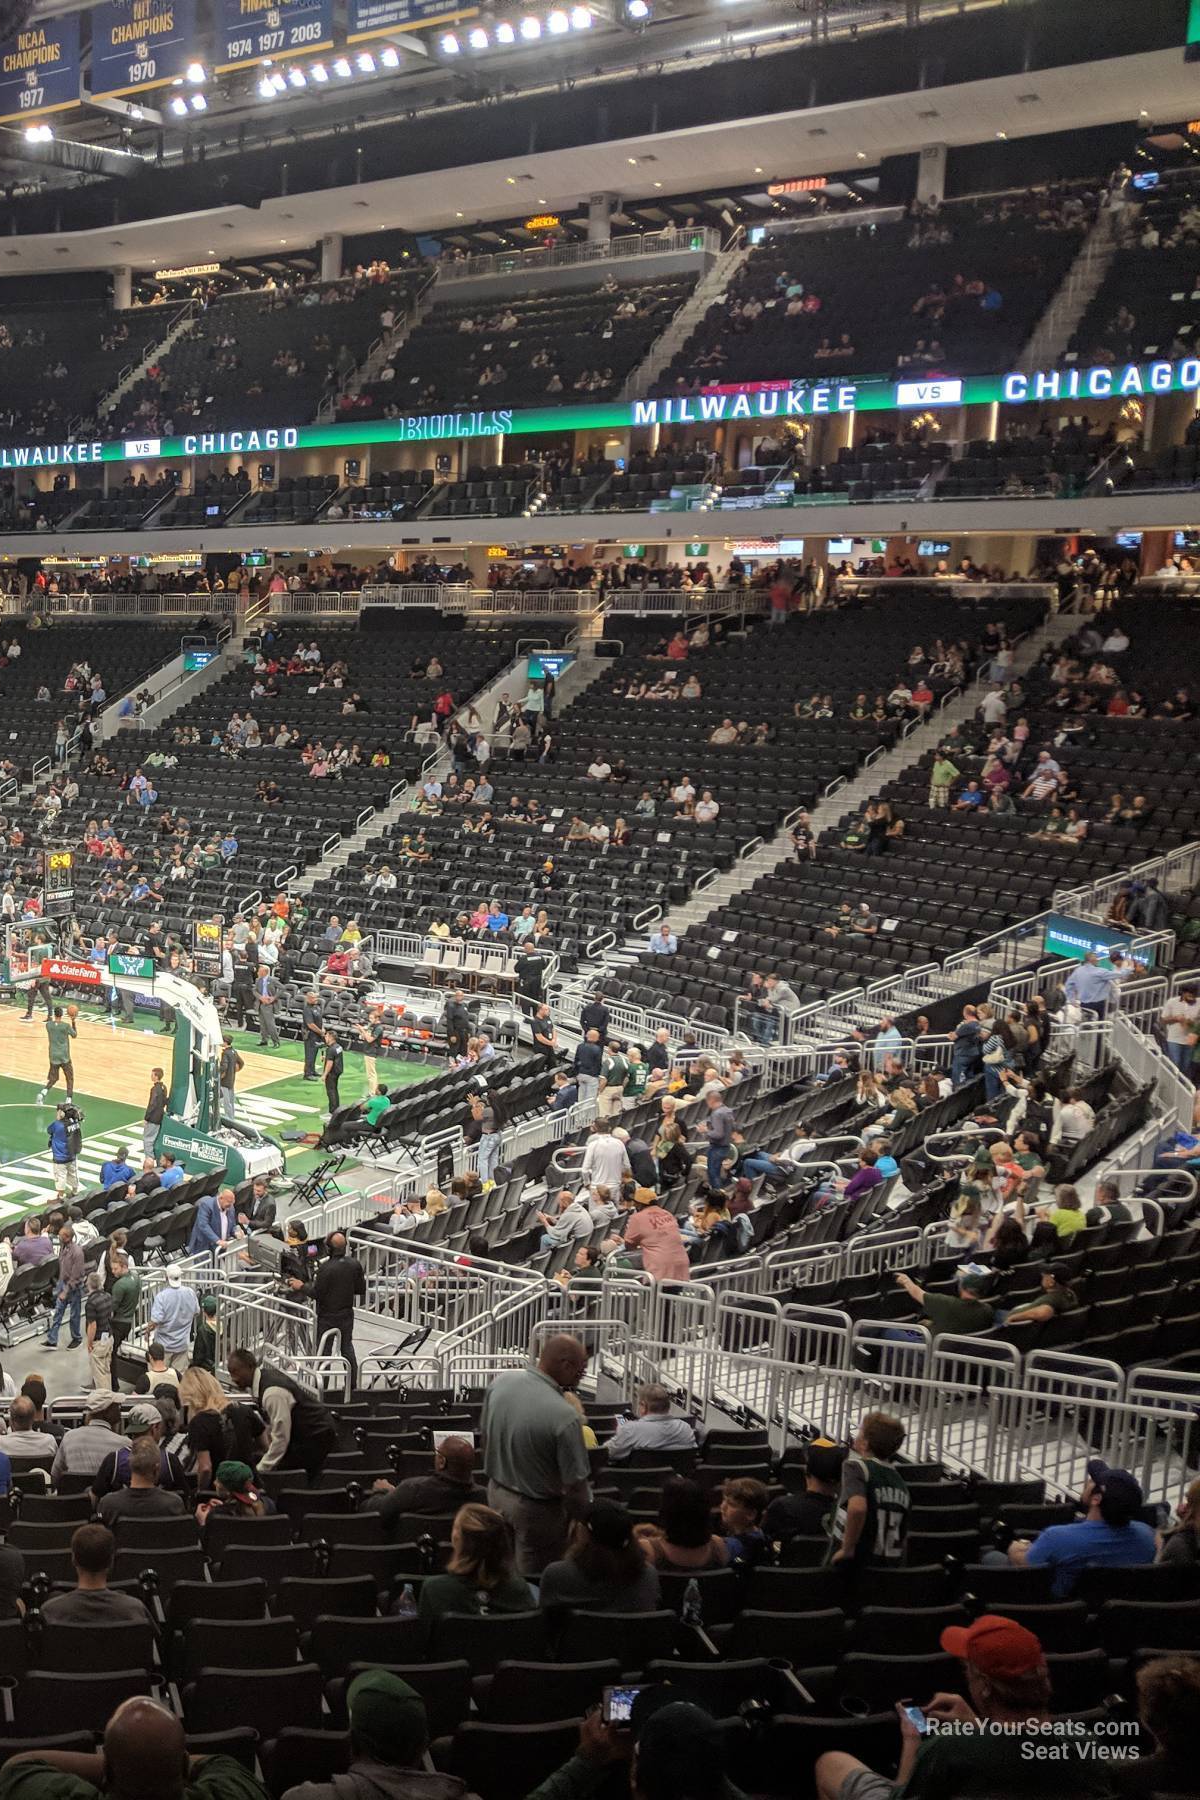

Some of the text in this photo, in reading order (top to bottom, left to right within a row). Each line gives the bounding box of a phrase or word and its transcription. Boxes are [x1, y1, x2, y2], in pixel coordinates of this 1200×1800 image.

[18, 29, 46, 50] NCAA
[111, 13, 174, 45] CHAMPIONS
[227, 21, 321, 59] 1974 1977 2003
[3, 43, 61, 72] CHAMPIONS
[128, 59, 156, 83] 1970
[19, 87, 44, 109] 1977
[634, 360, 1200, 424] MILWAUKEE VS CHICAGO
[135, 443, 150, 454] VS
[184, 428, 297, 454] CHICAGO
[54, 890, 75, 900] TISSOT
[164, 1136, 192, 1150] Froedtert
[0, 1260, 9, 1275] 6
